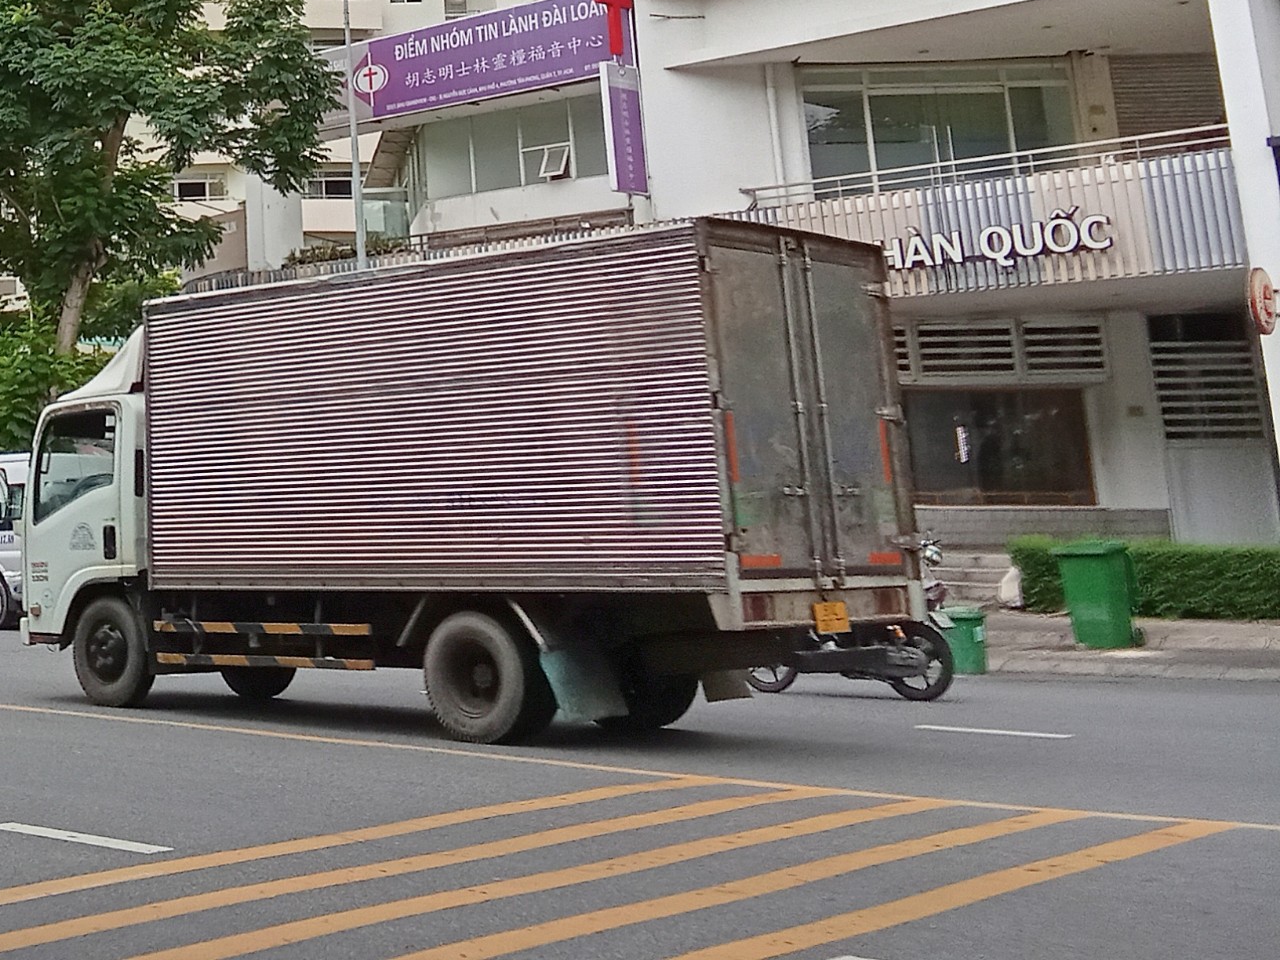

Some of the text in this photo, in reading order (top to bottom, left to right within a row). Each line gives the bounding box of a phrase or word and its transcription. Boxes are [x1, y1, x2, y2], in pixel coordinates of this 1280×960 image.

[394, 33, 429, 61] ĐIỂM
[430, 26, 474, 53] NHÓM
[476, 23, 499, 43] TIN
[502, 13, 539, 37] LÀNH
[541, 5, 567, 28] ĐÀI
[979, 205, 1113, 267] QUỐC
